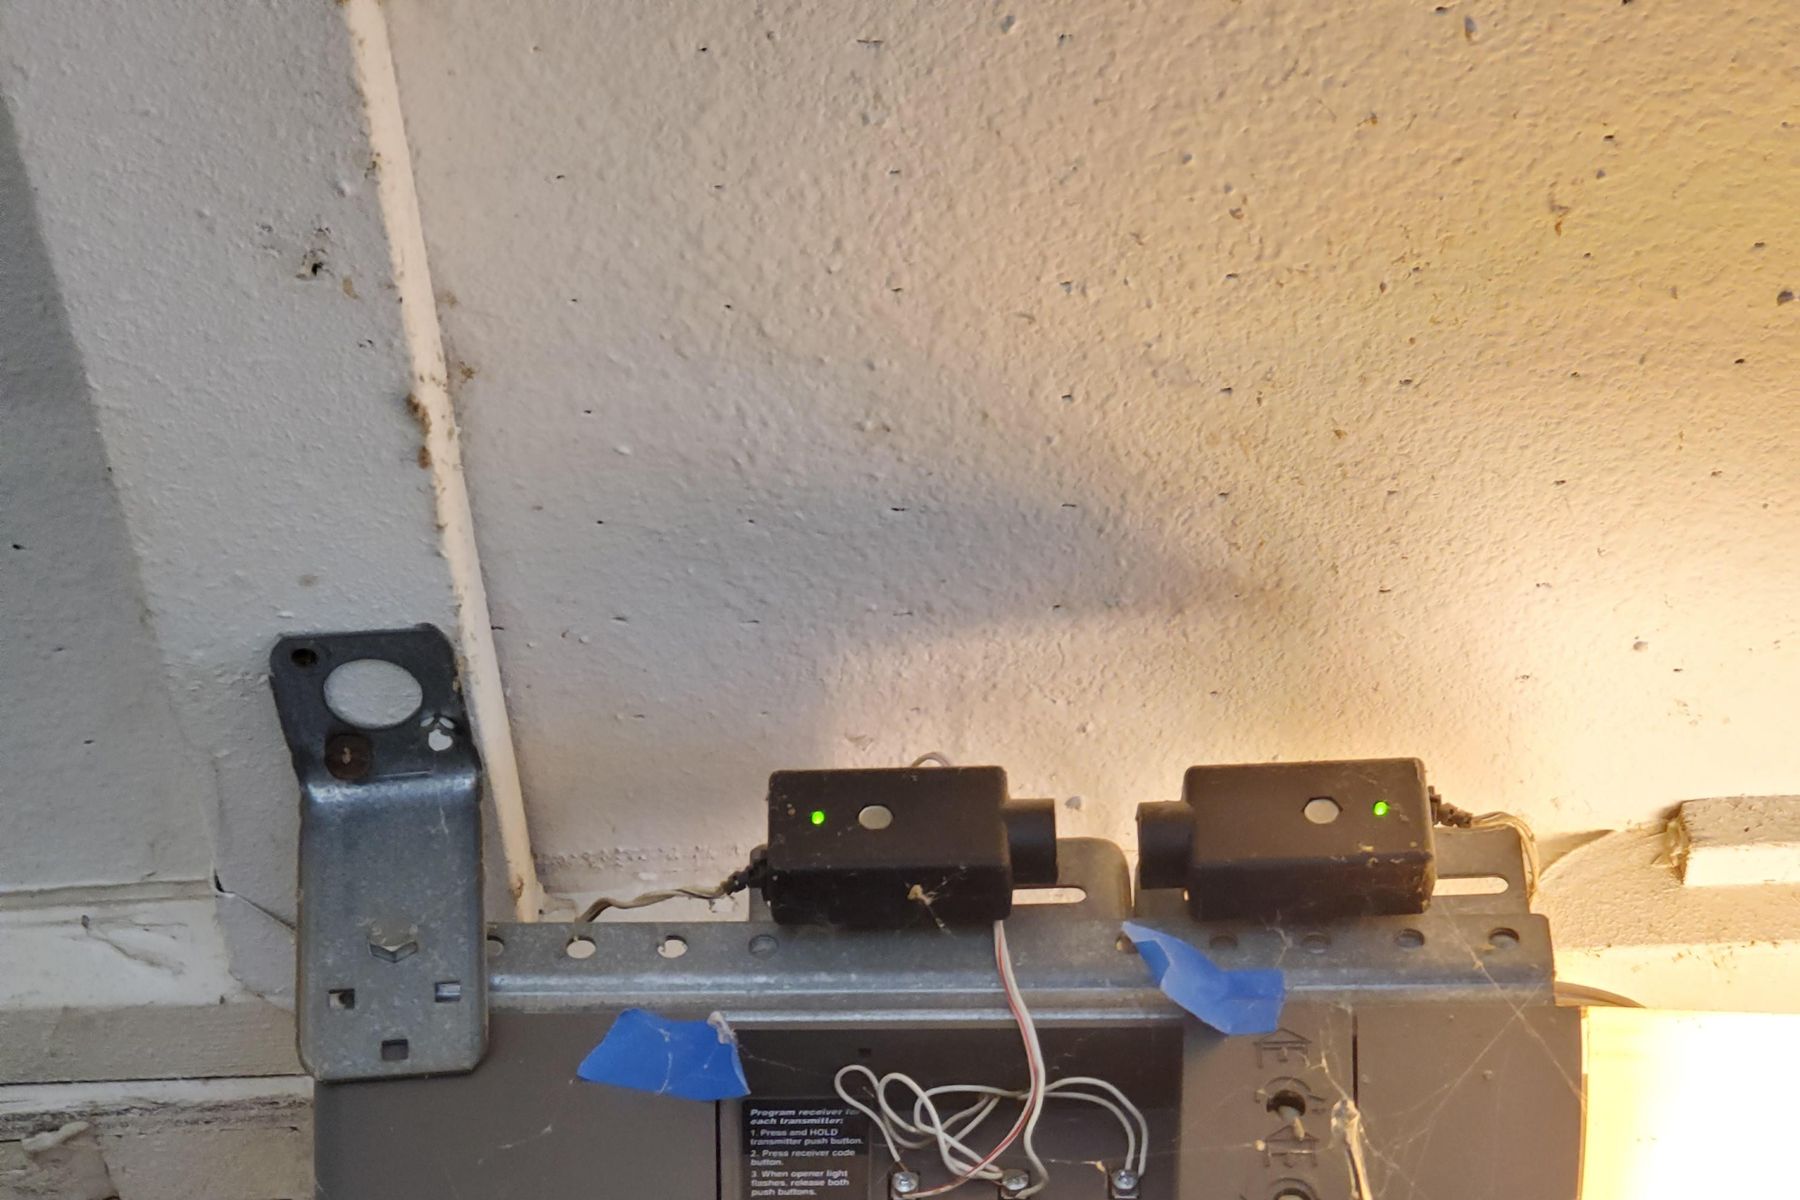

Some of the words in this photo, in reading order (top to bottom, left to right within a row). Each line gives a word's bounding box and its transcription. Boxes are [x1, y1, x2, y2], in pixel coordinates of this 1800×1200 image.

[750, 1109, 795, 1117] Program
[826, 1169, 848, 1178] light
[778, 1188, 816, 1196] buttons.
